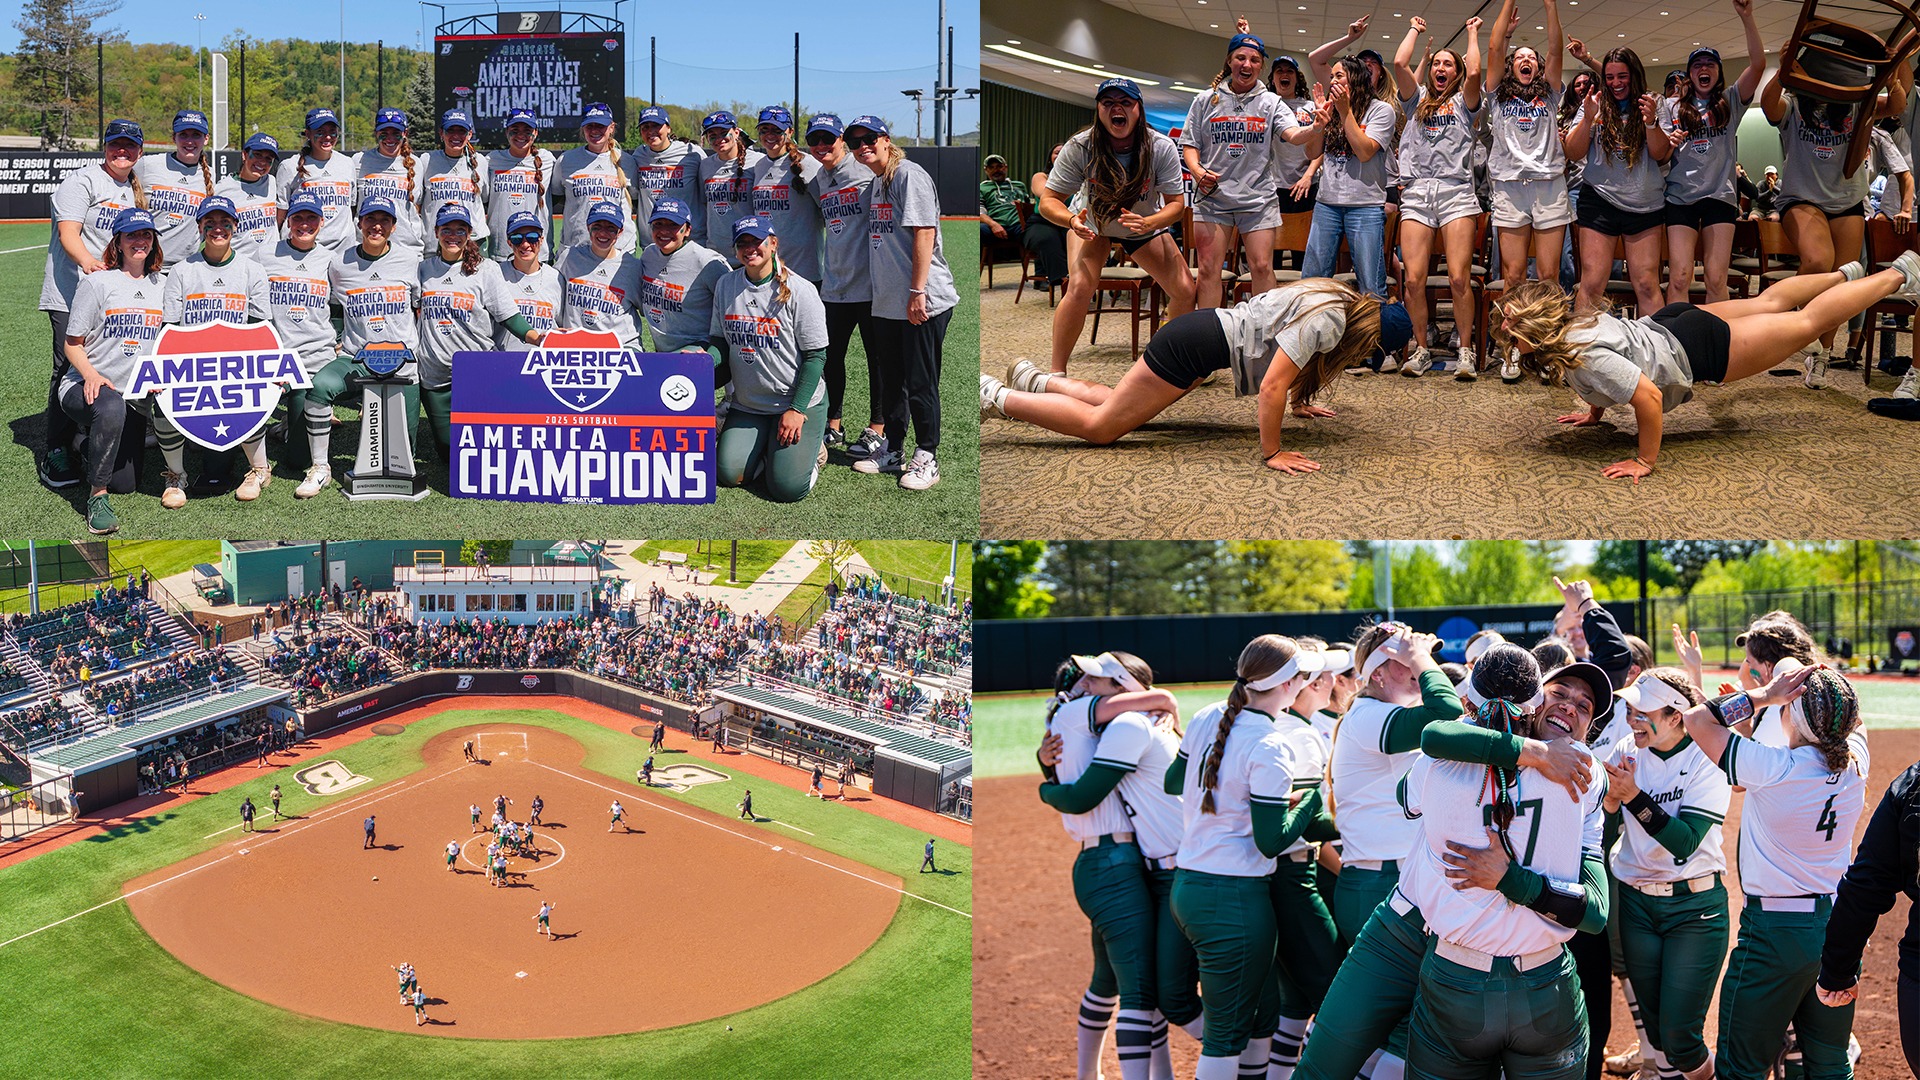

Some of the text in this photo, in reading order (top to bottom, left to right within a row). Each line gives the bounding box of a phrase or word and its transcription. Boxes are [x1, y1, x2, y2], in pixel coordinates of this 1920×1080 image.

[517, 13, 540, 33] B
[478, 61, 580, 87] AMERICA EAST
[476, 86, 582, 117] CHAMPIONS
[1210, 122, 1265, 132] AMERICA EAST
[1212, 132, 1265, 144] CHAMPIONS
[12, 158, 51, 169] SEASON
[24, 169, 50, 180] 2024
[494, 174, 536, 184] AMERICA EA
[572, 177, 604, 187] AMERICA
[32, 183, 60, 194] CHAM
[398, 180, 408, 190] EA
[461, 183, 475, 193] EAS
[494, 183, 538, 194] CHAMPION
[572, 186, 621, 199] CHAMPIONS
[152, 190, 203, 206] AMERICA EAS
[364, 186, 410, 201] CHAMPION
[753, 189, 789, 200] ERICA EAST
[840, 192, 859, 205] EAST
[149, 199, 200, 217] CHAMPION
[237, 206, 277, 221] MERICA EAS
[754, 200, 790, 212] AMPIONS
[824, 203, 863, 220] AMPIONS
[878, 209, 893, 220] EAST
[270, 281, 328, 297] AMERICA EAST
[568, 284, 602, 299] AMERICA
[664, 288, 684, 302] EAST
[185, 299, 247, 311] AMERICA EAST
[270, 292, 326, 309] CHAMPIONS
[346, 291, 406, 306] AMERICA EAST
[453, 298, 475, 311] EAST
[568, 294, 621, 316] CHAMPIONS
[185, 310, 244, 325] CHAMPIONS
[347, 302, 405, 318] CHAMPIONS
[105, 314, 162, 327] AMERICA EAS
[103, 326, 158, 340] CHAMPION
[757, 322, 780, 337] EAST
[356, 350, 412, 359] AMERICA
[368, 357, 400, 365] EAST
[527, 350, 636, 374] AMERICA
[131, 353, 305, 394] AMERICA
[551, 369, 612, 386] EAST
[172, 382, 268, 413] EAST
[666, 382, 690, 401] B
[545, 415, 618, 425] 2025 SOFTBALL
[370, 401, 379, 468] CHAMPIONS
[458, 426, 708, 452] AMERICA EAST
[458, 448, 707, 499] CHAMPIONS
[456, 674, 475, 691] B
[337, 698, 379, 718] AMERICA EAST
[1815, 793, 1838, 842] 4
